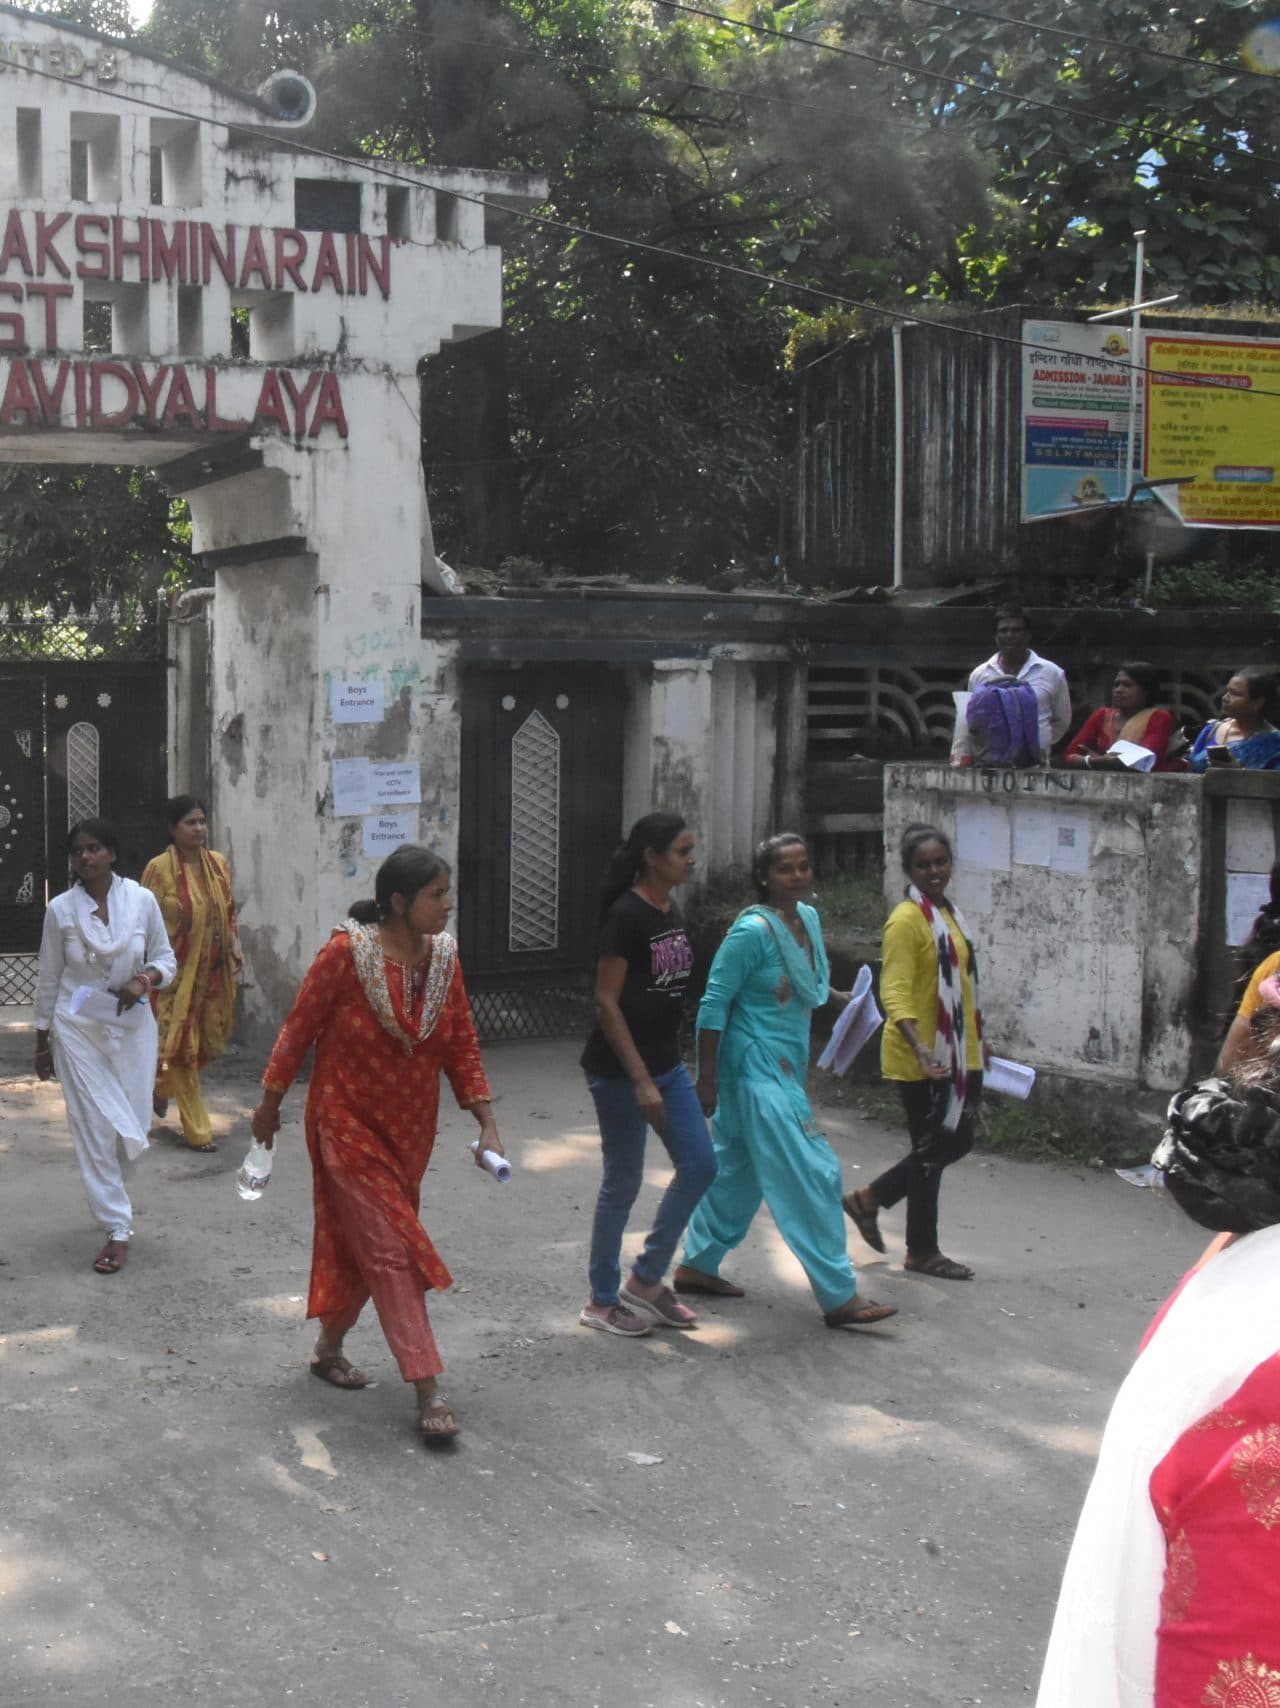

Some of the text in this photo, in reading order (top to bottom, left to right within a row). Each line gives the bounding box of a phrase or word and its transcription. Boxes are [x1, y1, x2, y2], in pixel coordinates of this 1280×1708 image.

[1033, 369, 1086, 384] ADMISSION
[347, 686, 367, 696] Boys
[340, 698, 375, 707] Entrance
[379, 820, 398, 829] Boys
[371, 832, 406, 841] Entrance
